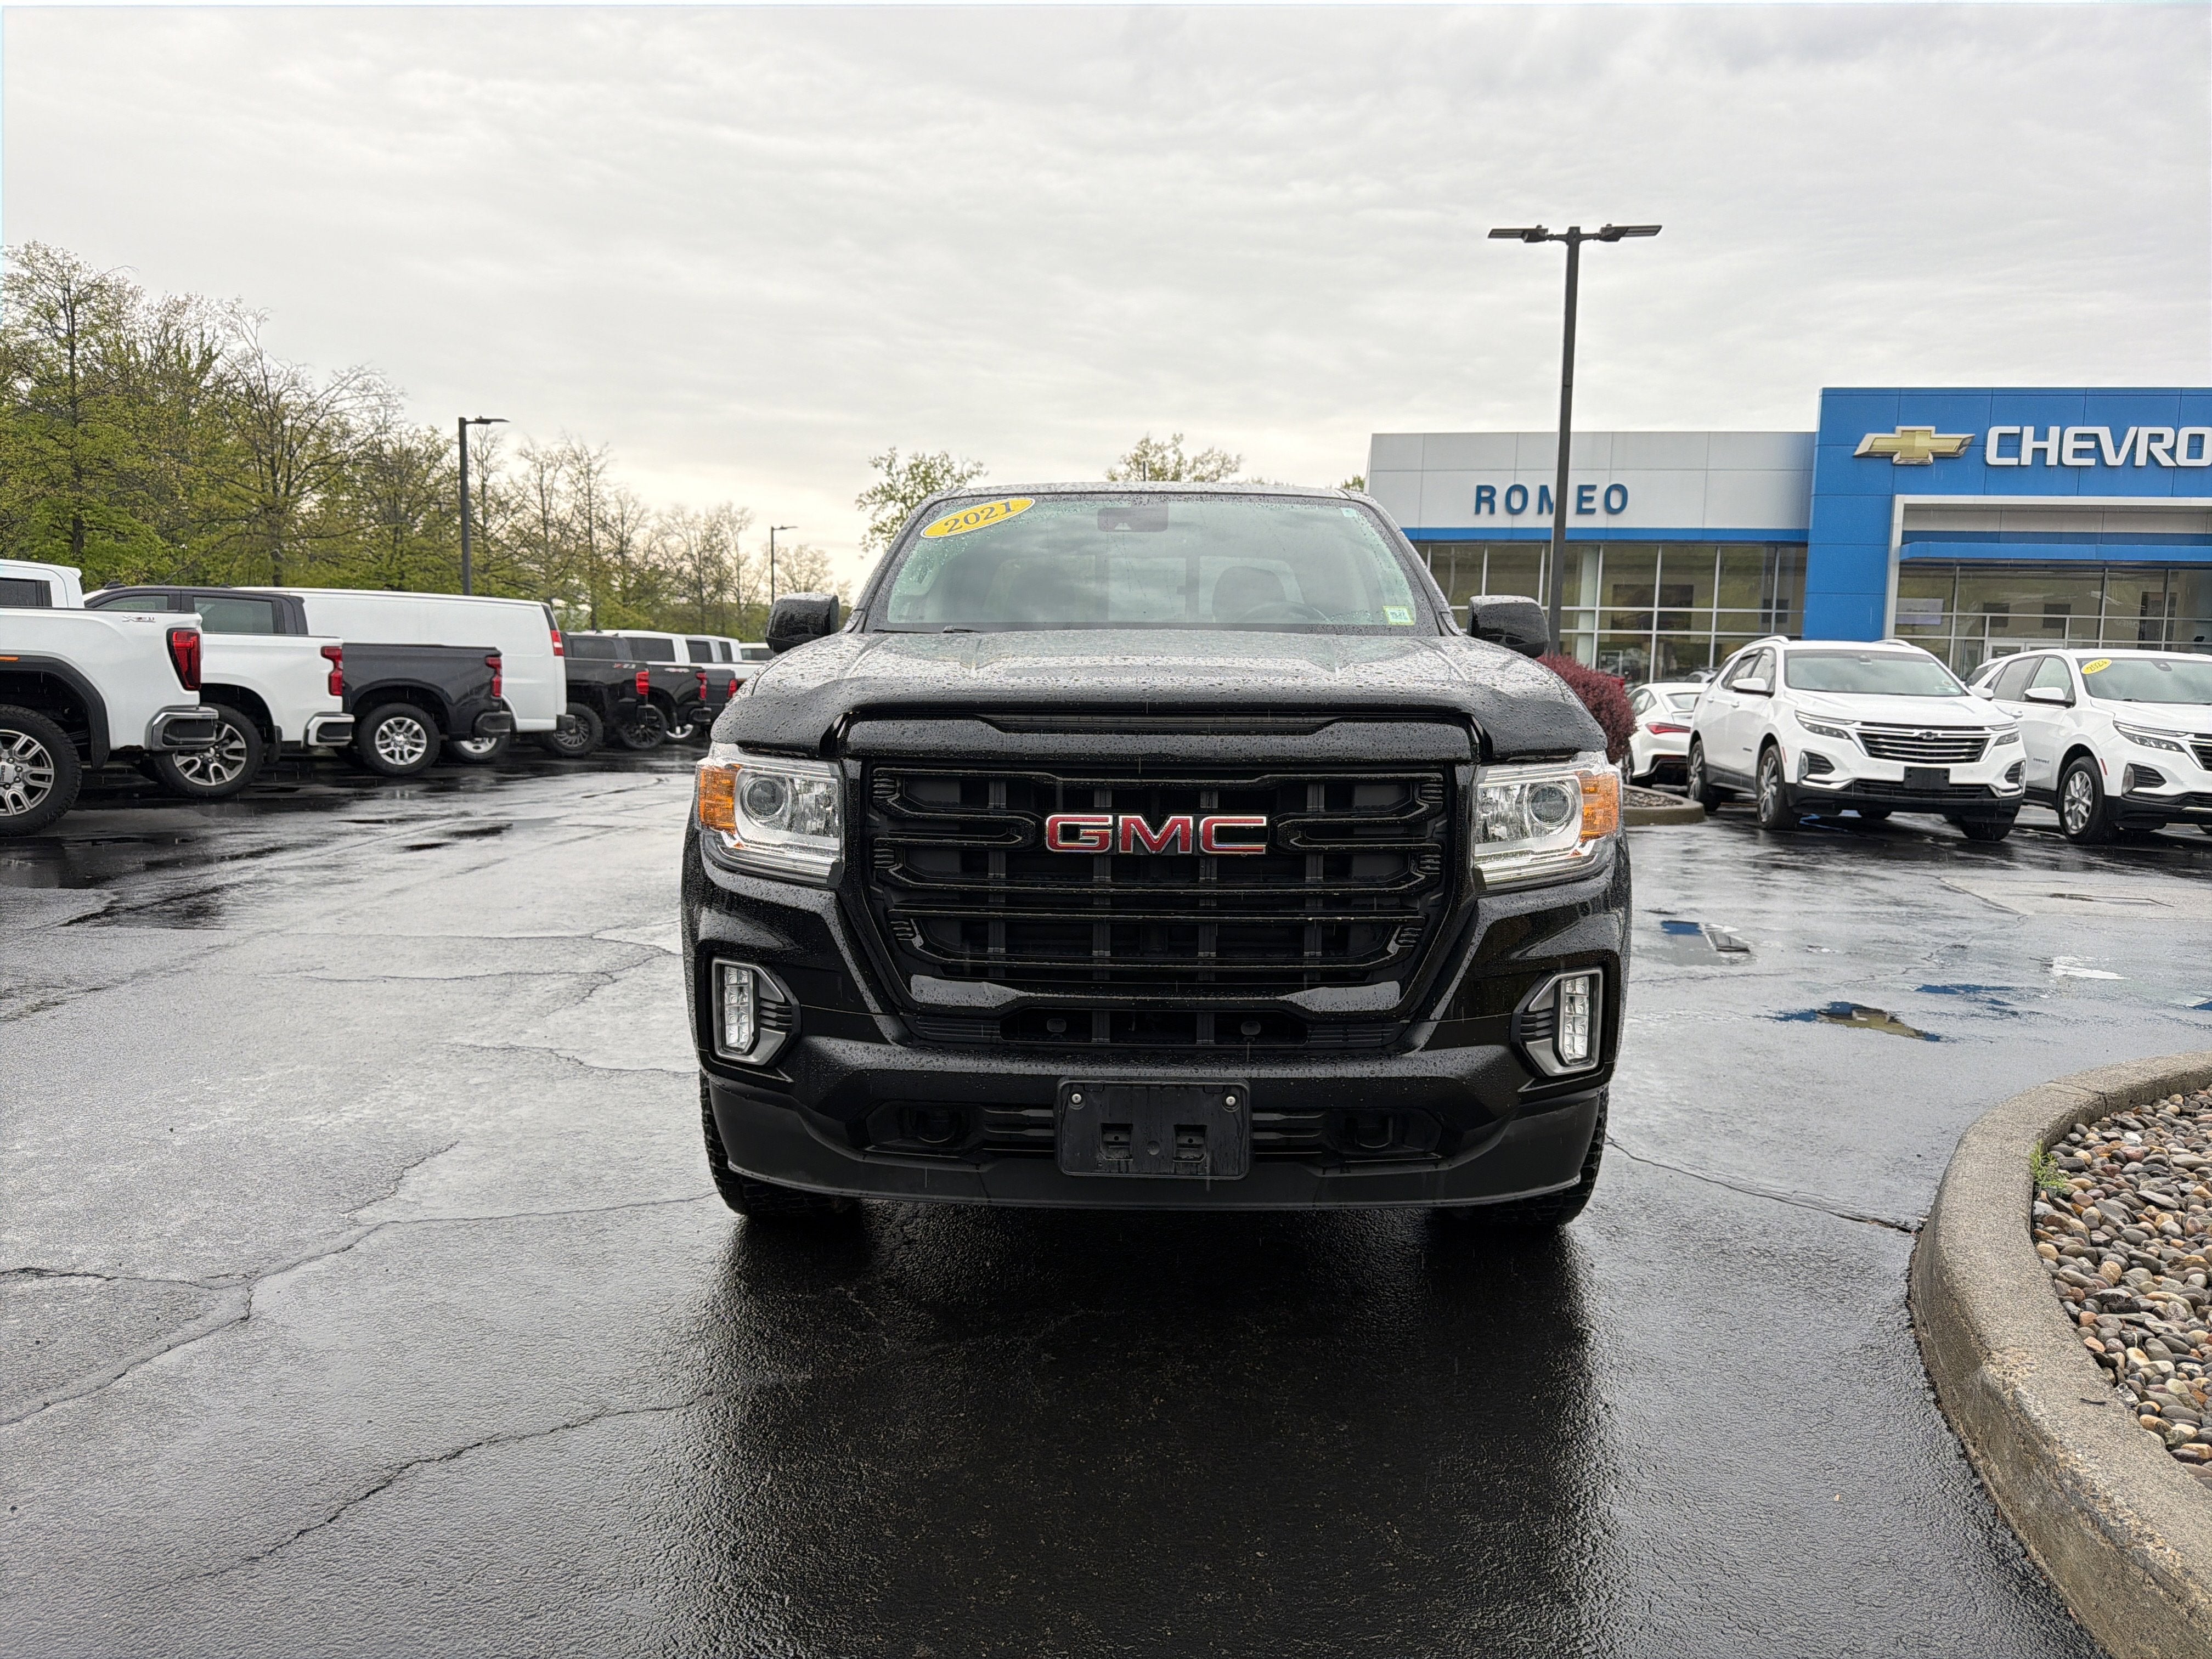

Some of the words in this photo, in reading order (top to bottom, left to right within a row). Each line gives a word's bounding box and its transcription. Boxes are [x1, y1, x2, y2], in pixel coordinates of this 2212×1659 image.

[1985, 426, 2212, 466] CHEVRO
[944, 501, 1015, 533] 2021
[1046, 814, 1267, 855] GMC
